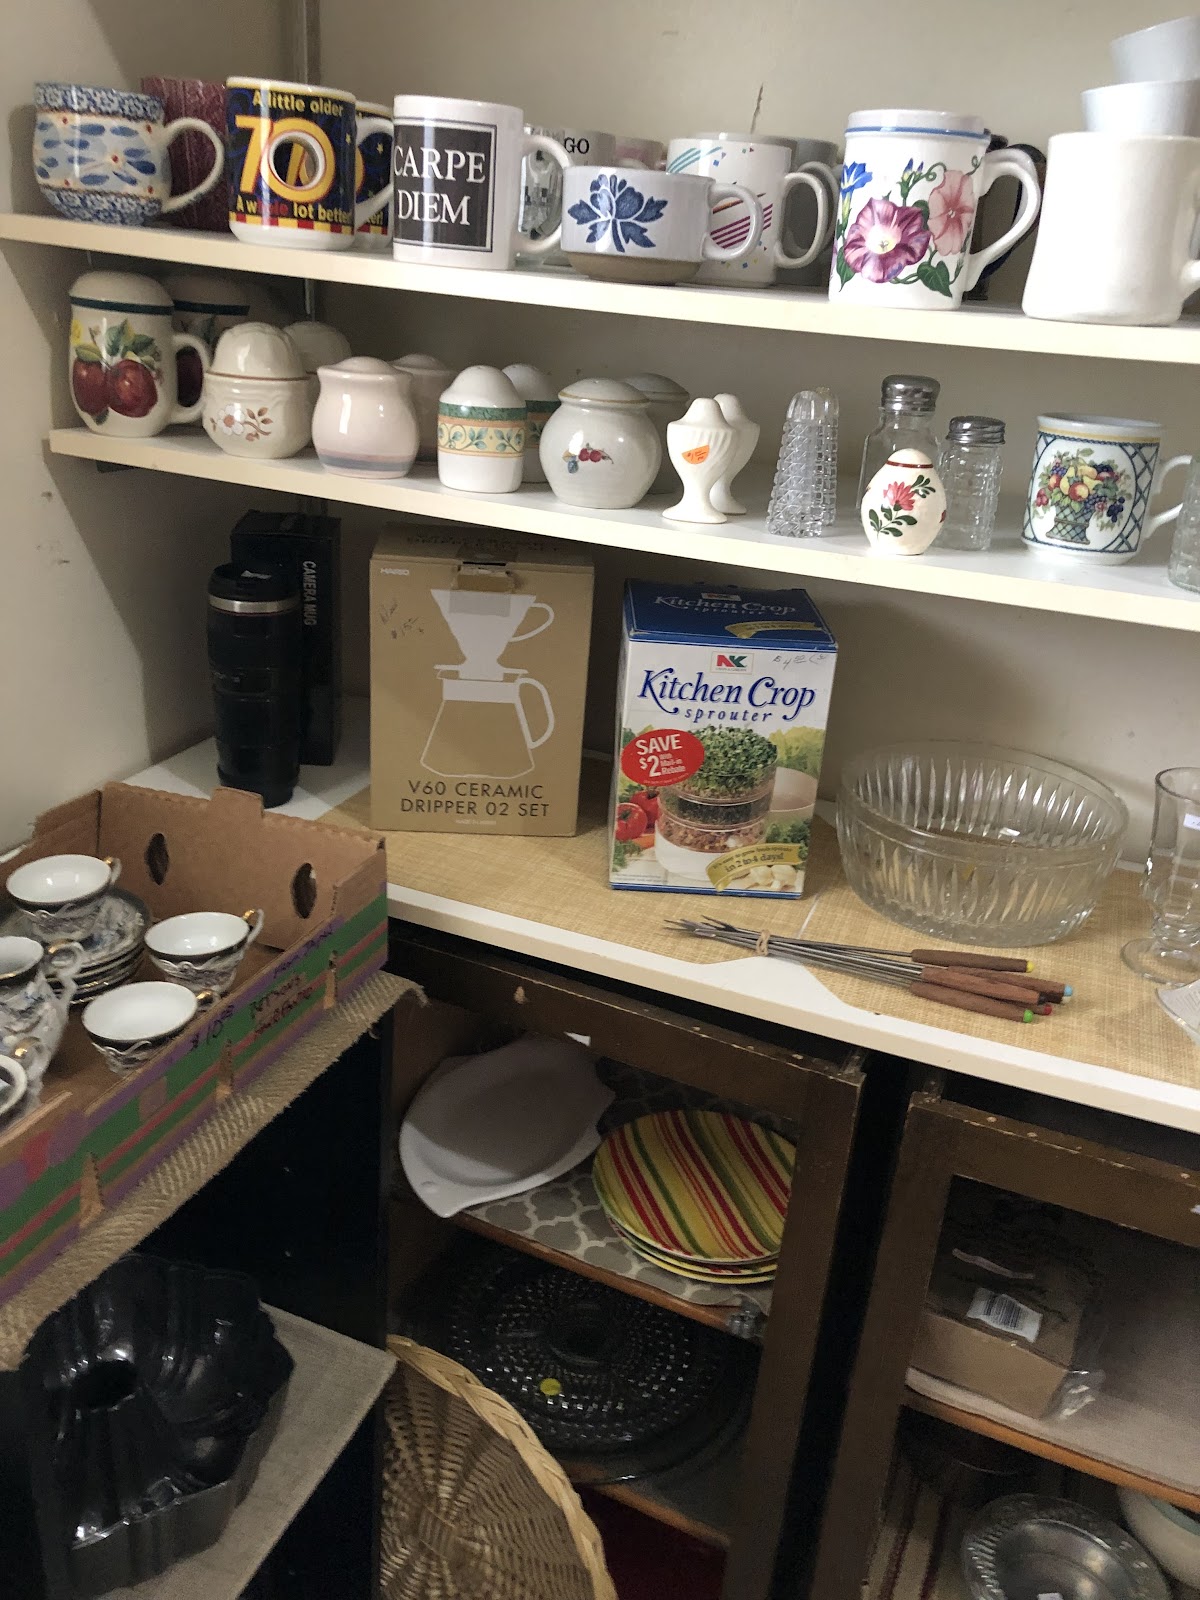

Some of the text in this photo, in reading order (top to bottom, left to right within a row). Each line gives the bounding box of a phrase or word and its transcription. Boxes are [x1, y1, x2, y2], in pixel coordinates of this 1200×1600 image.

[253, 89, 343, 117] A little older
[235, 115, 336, 202] 70
[394, 146, 486, 184] CARPE
[236, 197, 245, 212] A
[293, 203, 315, 219] lot
[398, 189, 471, 226] DIEM
[303, 561, 317, 626] CAMERA MUG
[654, 595, 737, 611] Kitchen
[741, 602, 796, 615] Crop
[637, 668, 816, 721] Kitchen Crop
[685, 706, 772, 723] sprouter
[635, 734, 683, 755] SAVE
[639, 755, 662, 777] $2
[408, 780, 544, 799] V60 CERAMIC
[400, 799, 550, 817] DRIPPER 02 SET
